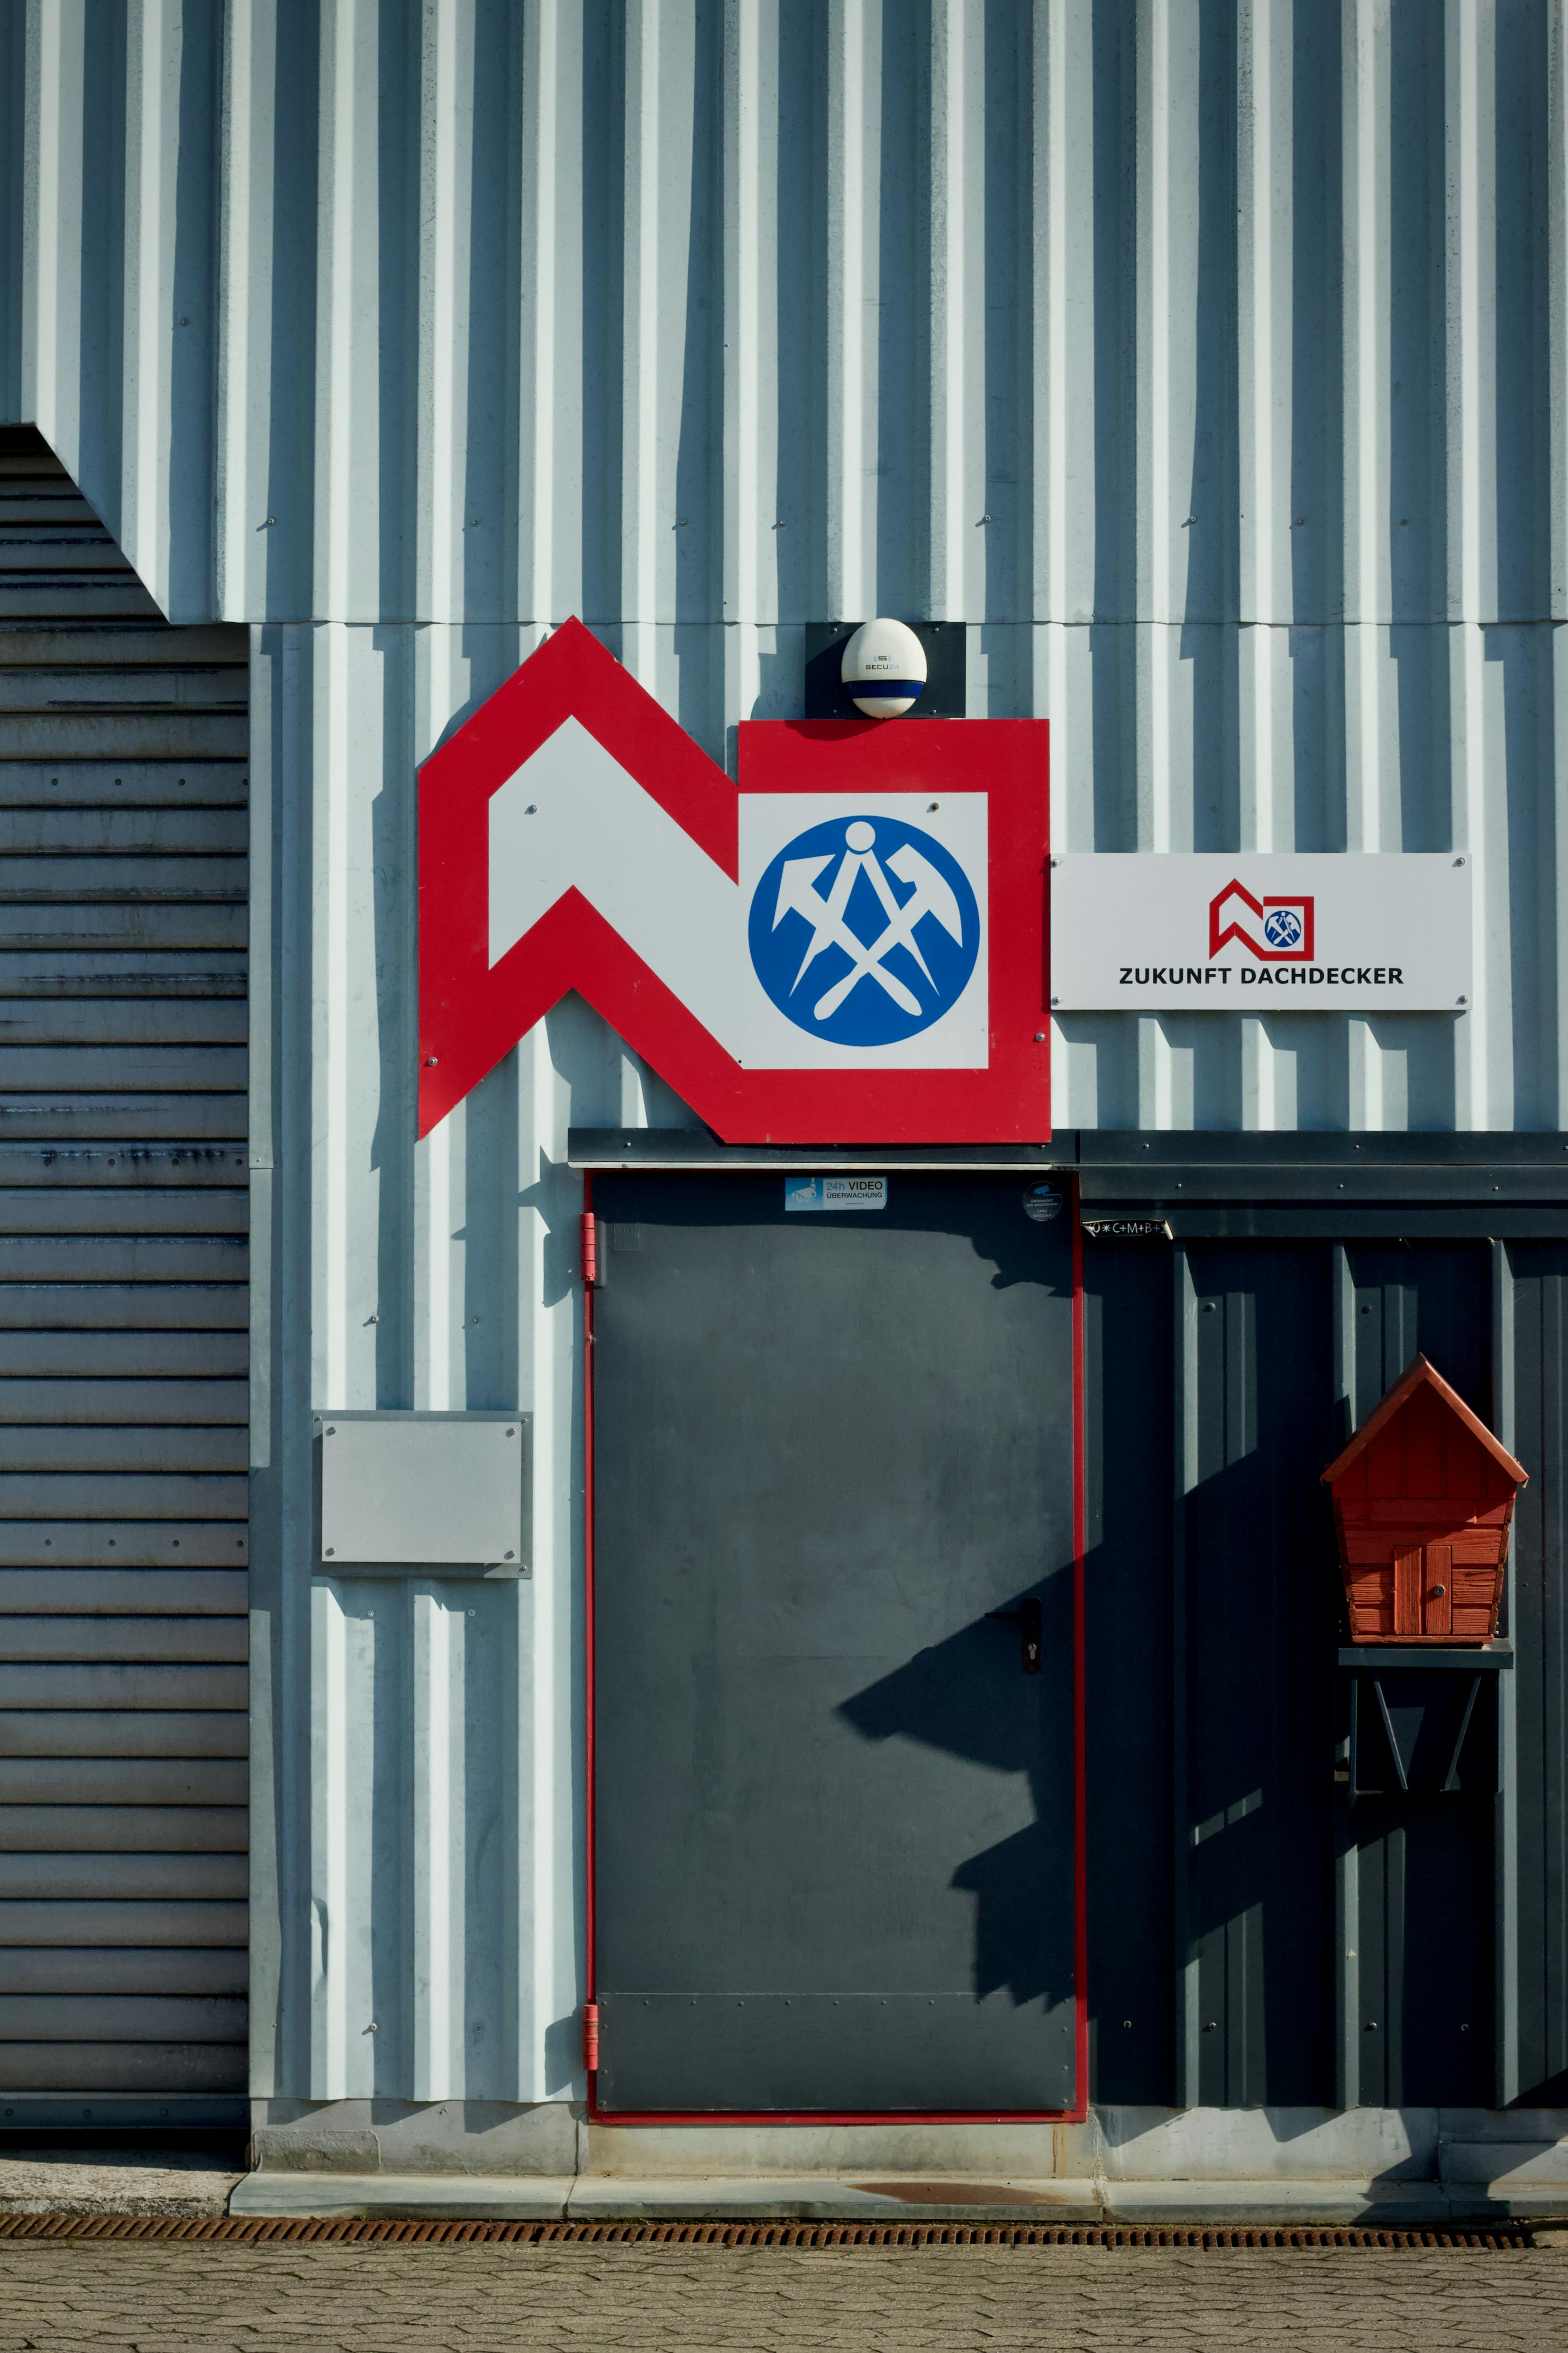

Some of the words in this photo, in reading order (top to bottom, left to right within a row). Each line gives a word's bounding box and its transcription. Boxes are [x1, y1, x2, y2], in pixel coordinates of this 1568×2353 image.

[1119, 968, 1232, 984] ZUKUNFT
[1241, 968, 1404, 984] DACHDECKER
[826, 1182, 845, 1190] 24h
[848, 1181, 883, 1190] VIDEO
